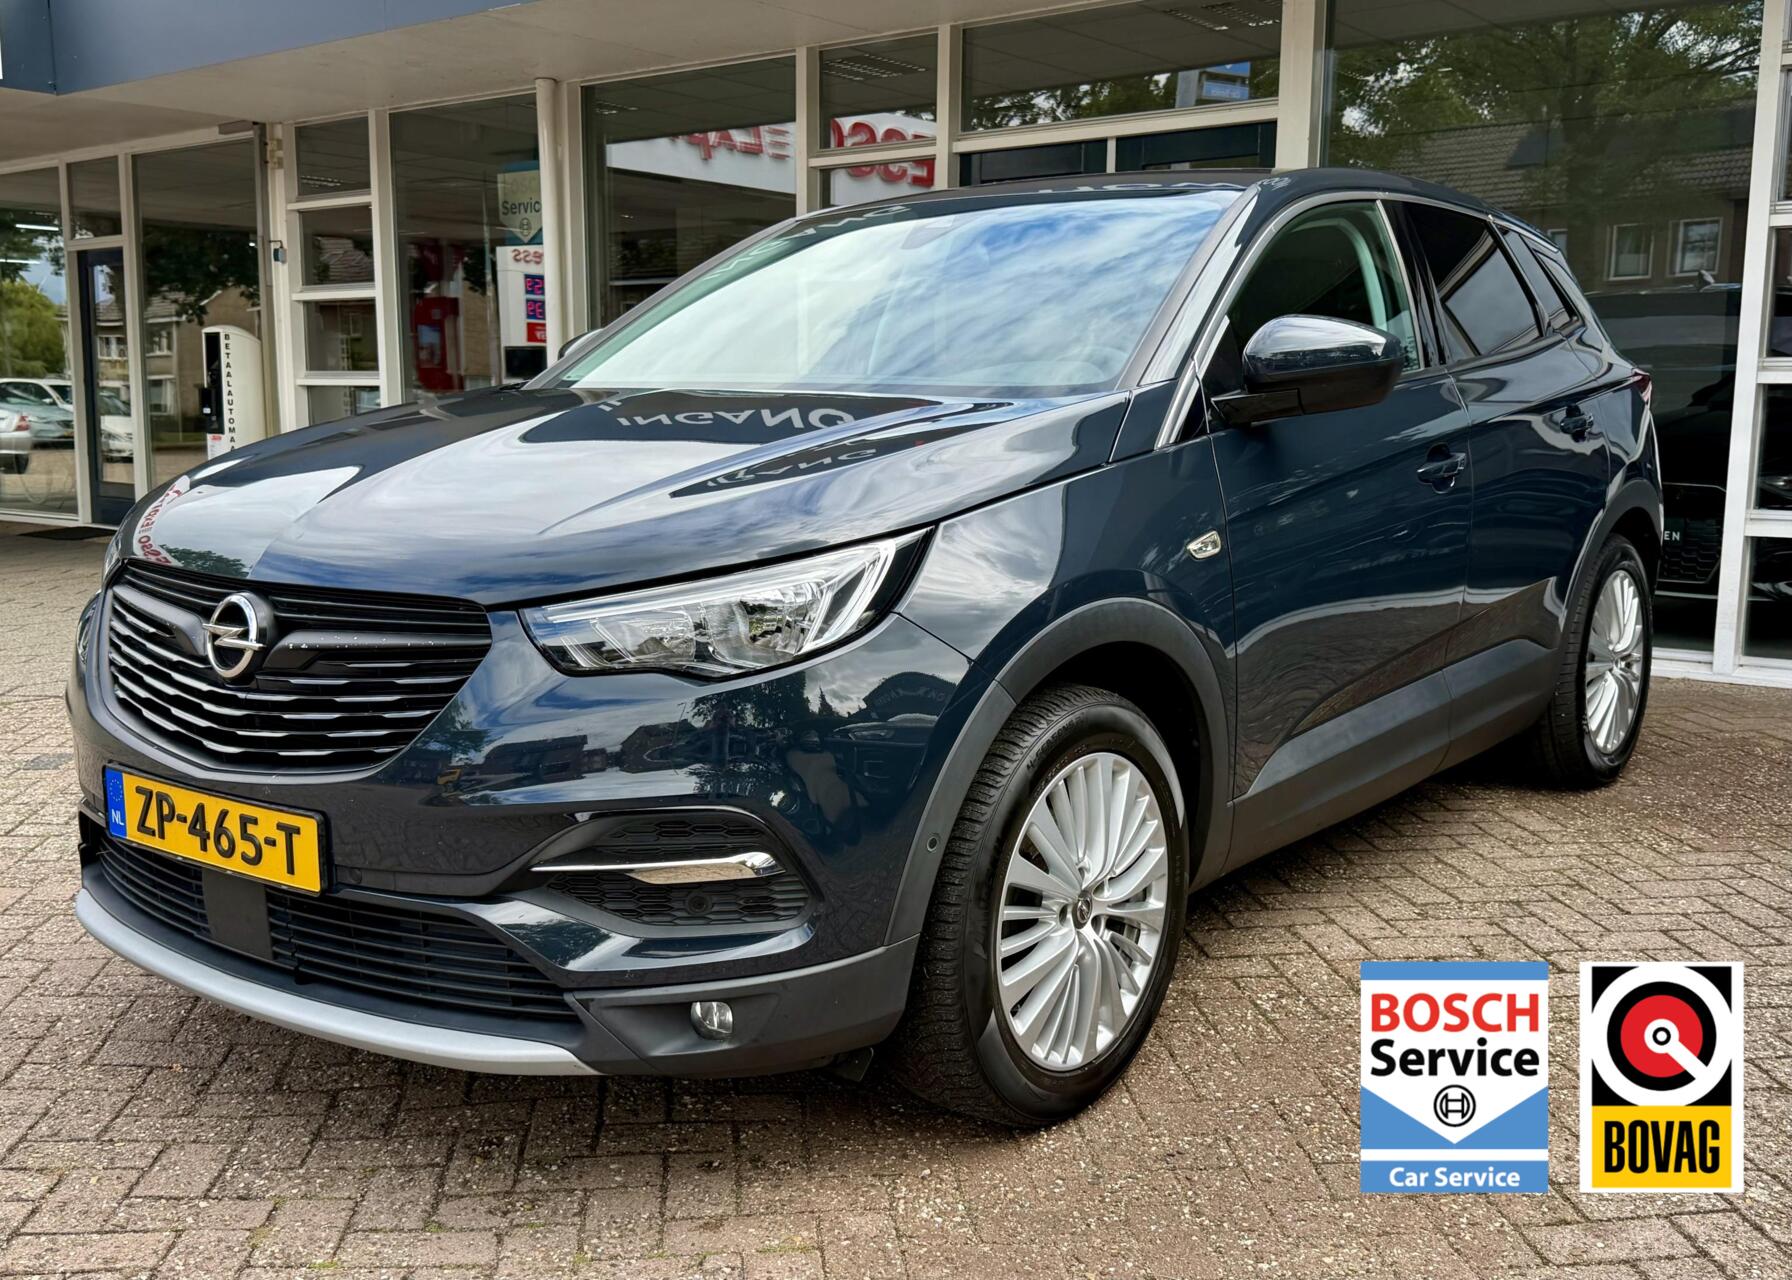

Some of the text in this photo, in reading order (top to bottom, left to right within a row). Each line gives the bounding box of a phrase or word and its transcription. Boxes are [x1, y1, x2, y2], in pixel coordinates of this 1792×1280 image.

[502, 197, 541, 216] Servic
[224, 333, 236, 452] BETAALAUTOMAA
[1663, 530, 1681, 541] EN
[111, 809, 125, 827] NL
[135, 785, 301, 876] ZP-465-T
